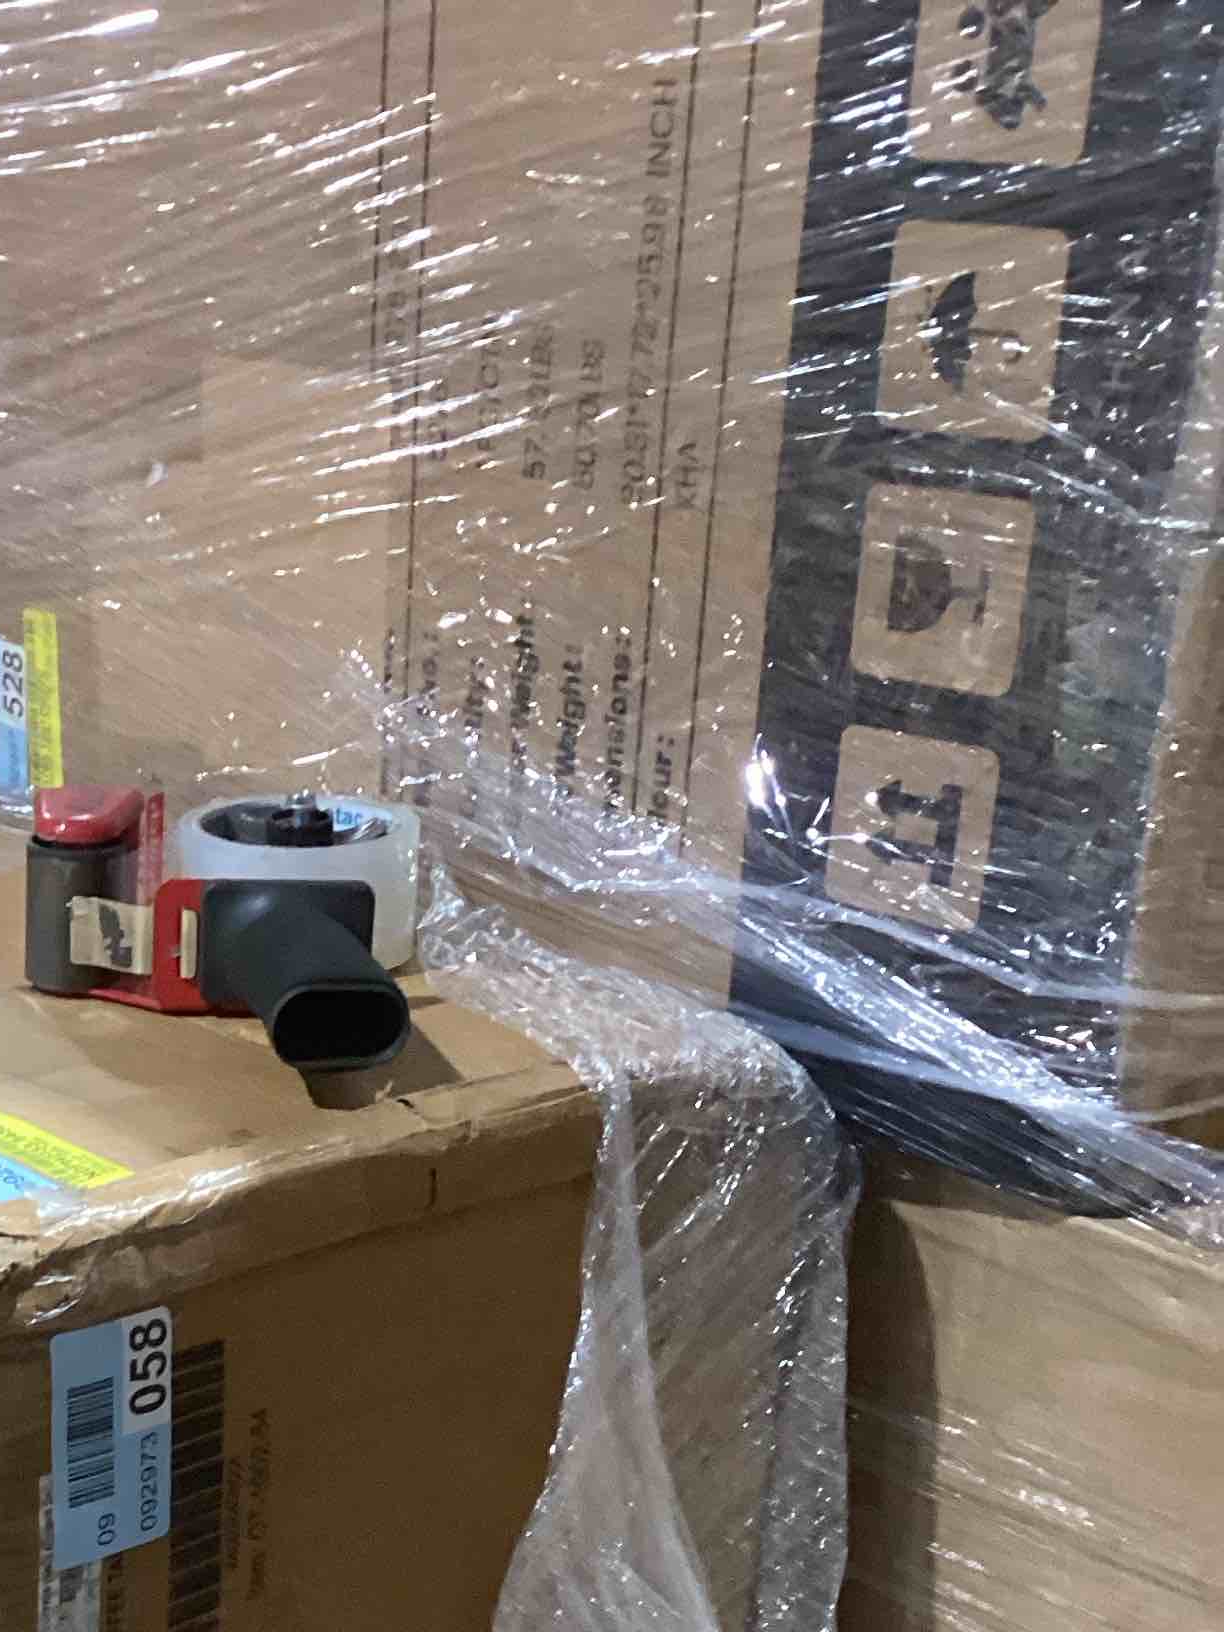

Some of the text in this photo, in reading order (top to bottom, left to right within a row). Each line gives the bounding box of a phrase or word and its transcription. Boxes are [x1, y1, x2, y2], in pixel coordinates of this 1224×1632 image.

[645, 79, 678, 178] INCH
[2, 649, 23, 719] 528
[129, 1318, 167, 1416] 058
[97, 1512, 116, 1547] 09
[140, 1431, 160, 1532] 092973
